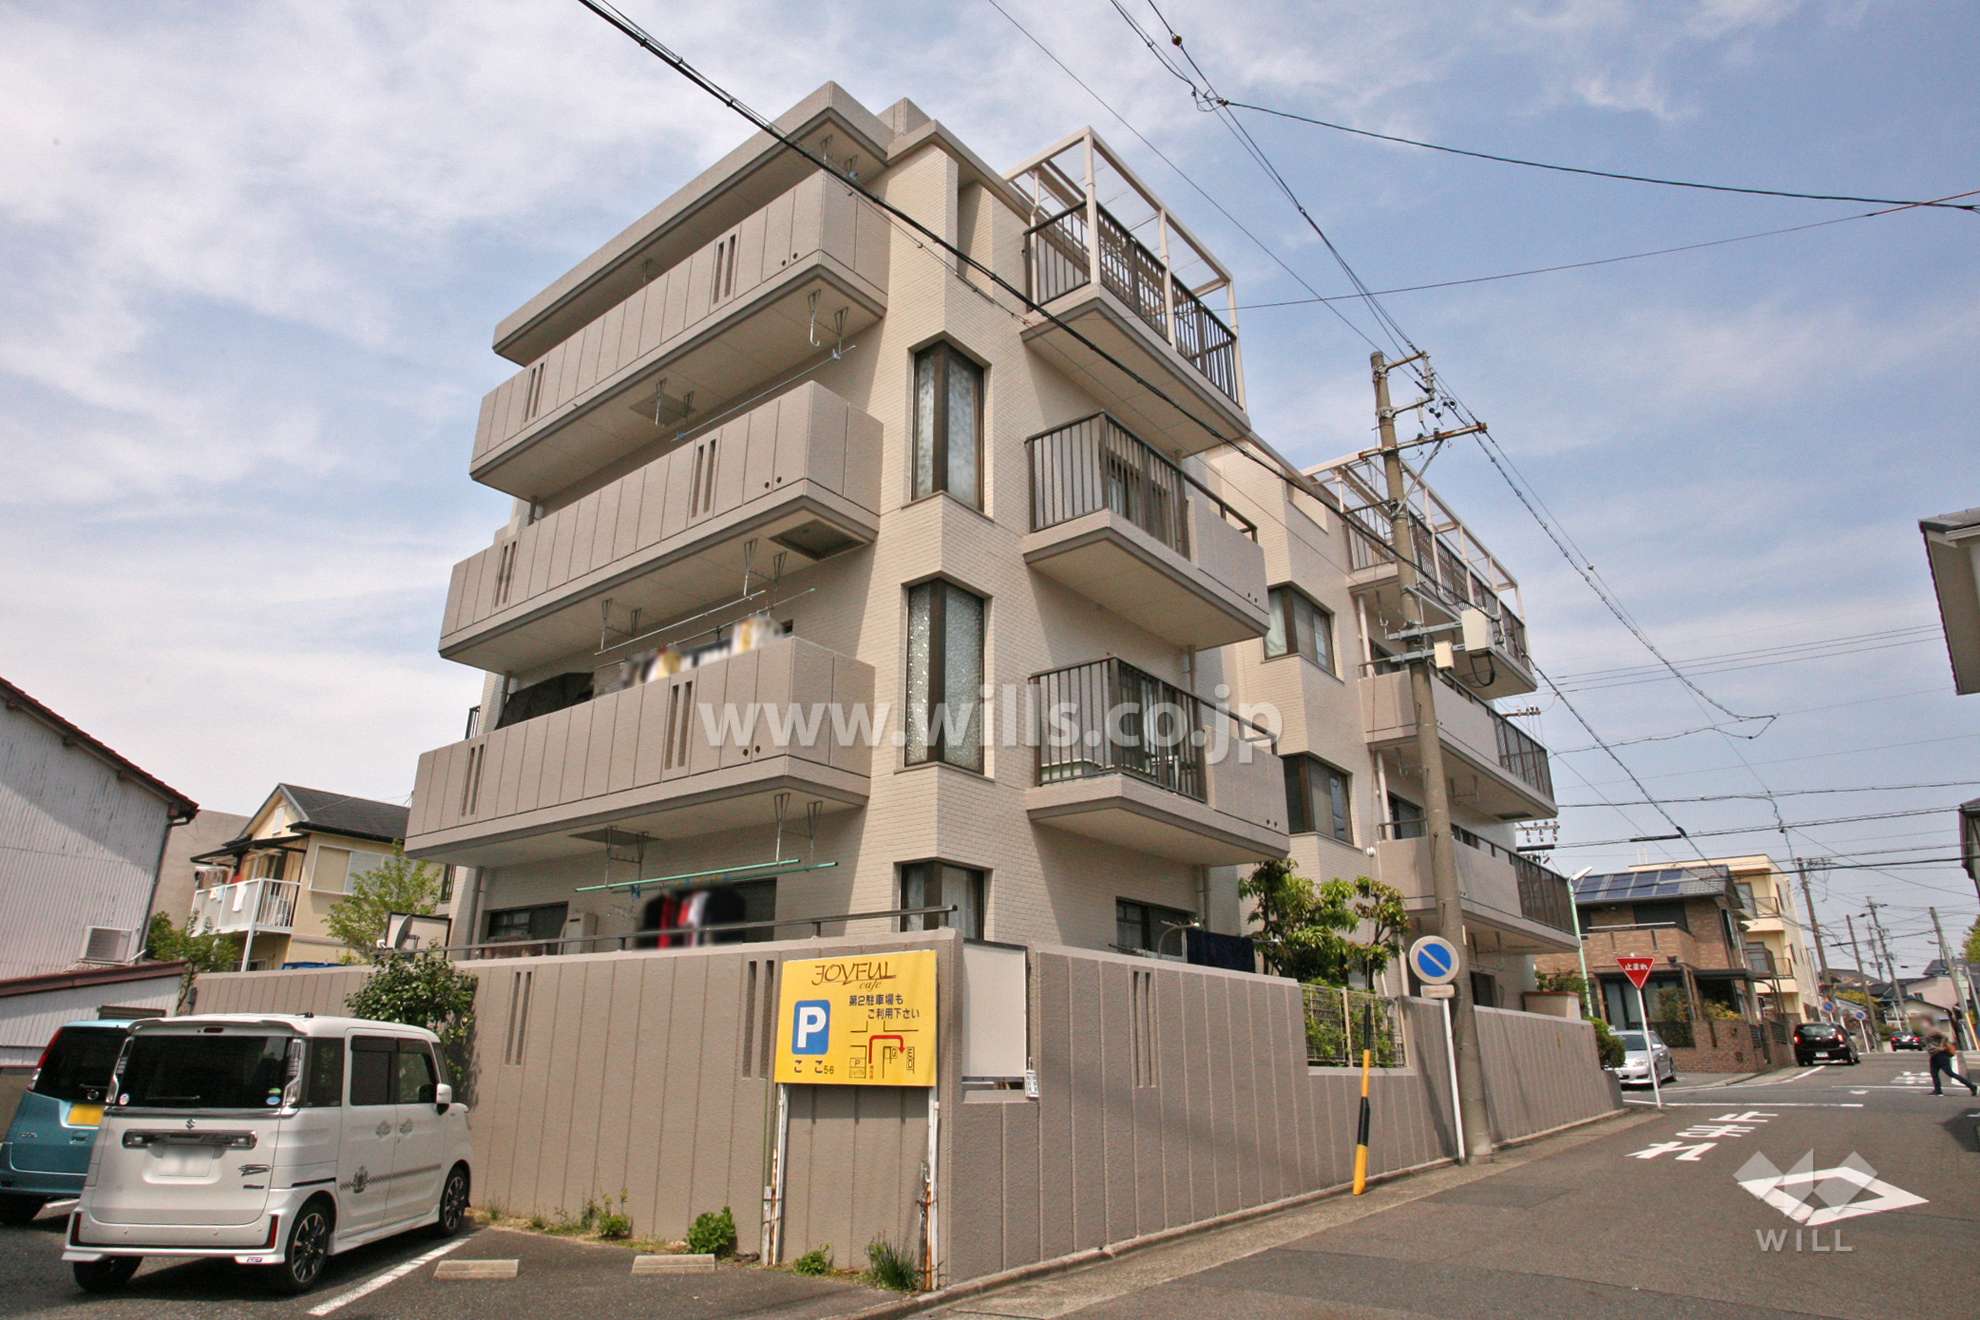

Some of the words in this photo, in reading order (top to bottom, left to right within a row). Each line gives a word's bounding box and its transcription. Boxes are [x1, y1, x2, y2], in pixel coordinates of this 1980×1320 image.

[811, 961, 897, 986] JOYFUL
[1624, 962, 1649, 971] 止まれ
[797, 1006, 826, 1048] P
[1624, 1111, 1780, 1162] 止まれ
